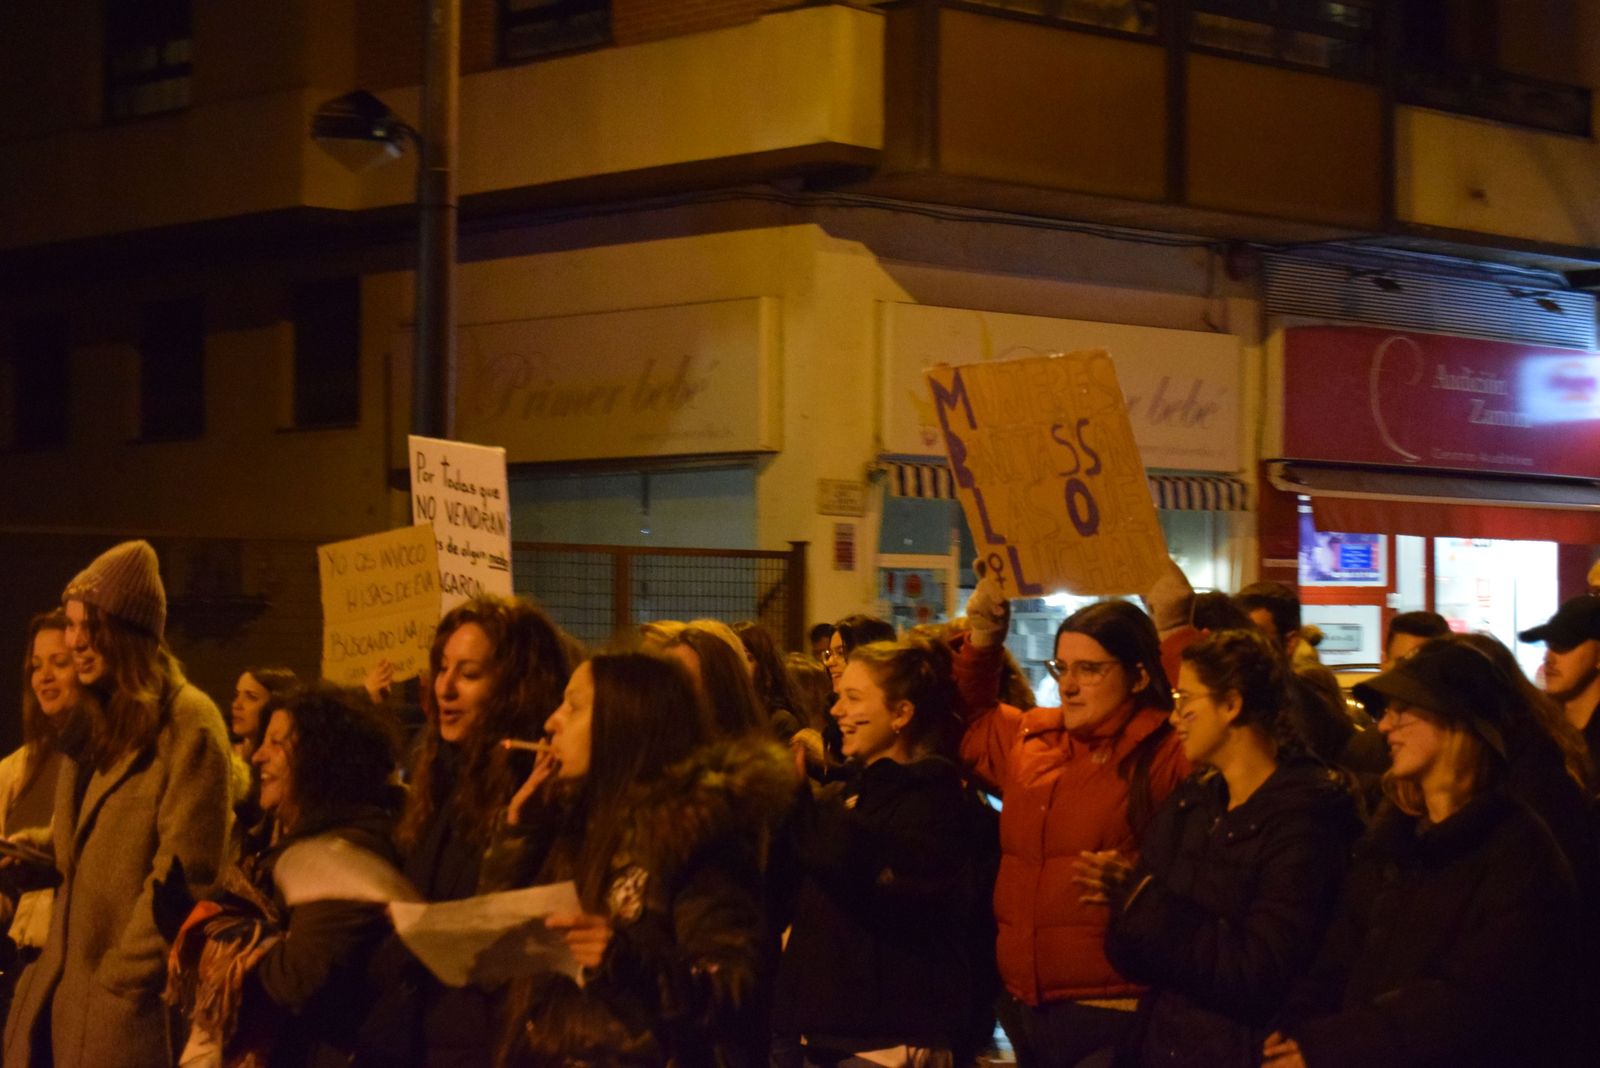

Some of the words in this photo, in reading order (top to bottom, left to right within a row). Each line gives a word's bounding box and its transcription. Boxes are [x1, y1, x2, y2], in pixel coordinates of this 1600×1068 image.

[928, 352, 1121, 430] MUJERES
[1146, 375, 1229, 430] bebé
[415, 451, 436, 483] Por
[479, 485, 501, 510] que
[416, 494, 437, 522] NO
[324, 548, 348, 579] YO
[447, 535, 459, 556] de
[345, 580, 395, 614] HIJAS
[329, 628, 395, 663] BUSCANDO
[397, 619, 418, 645] UNA
